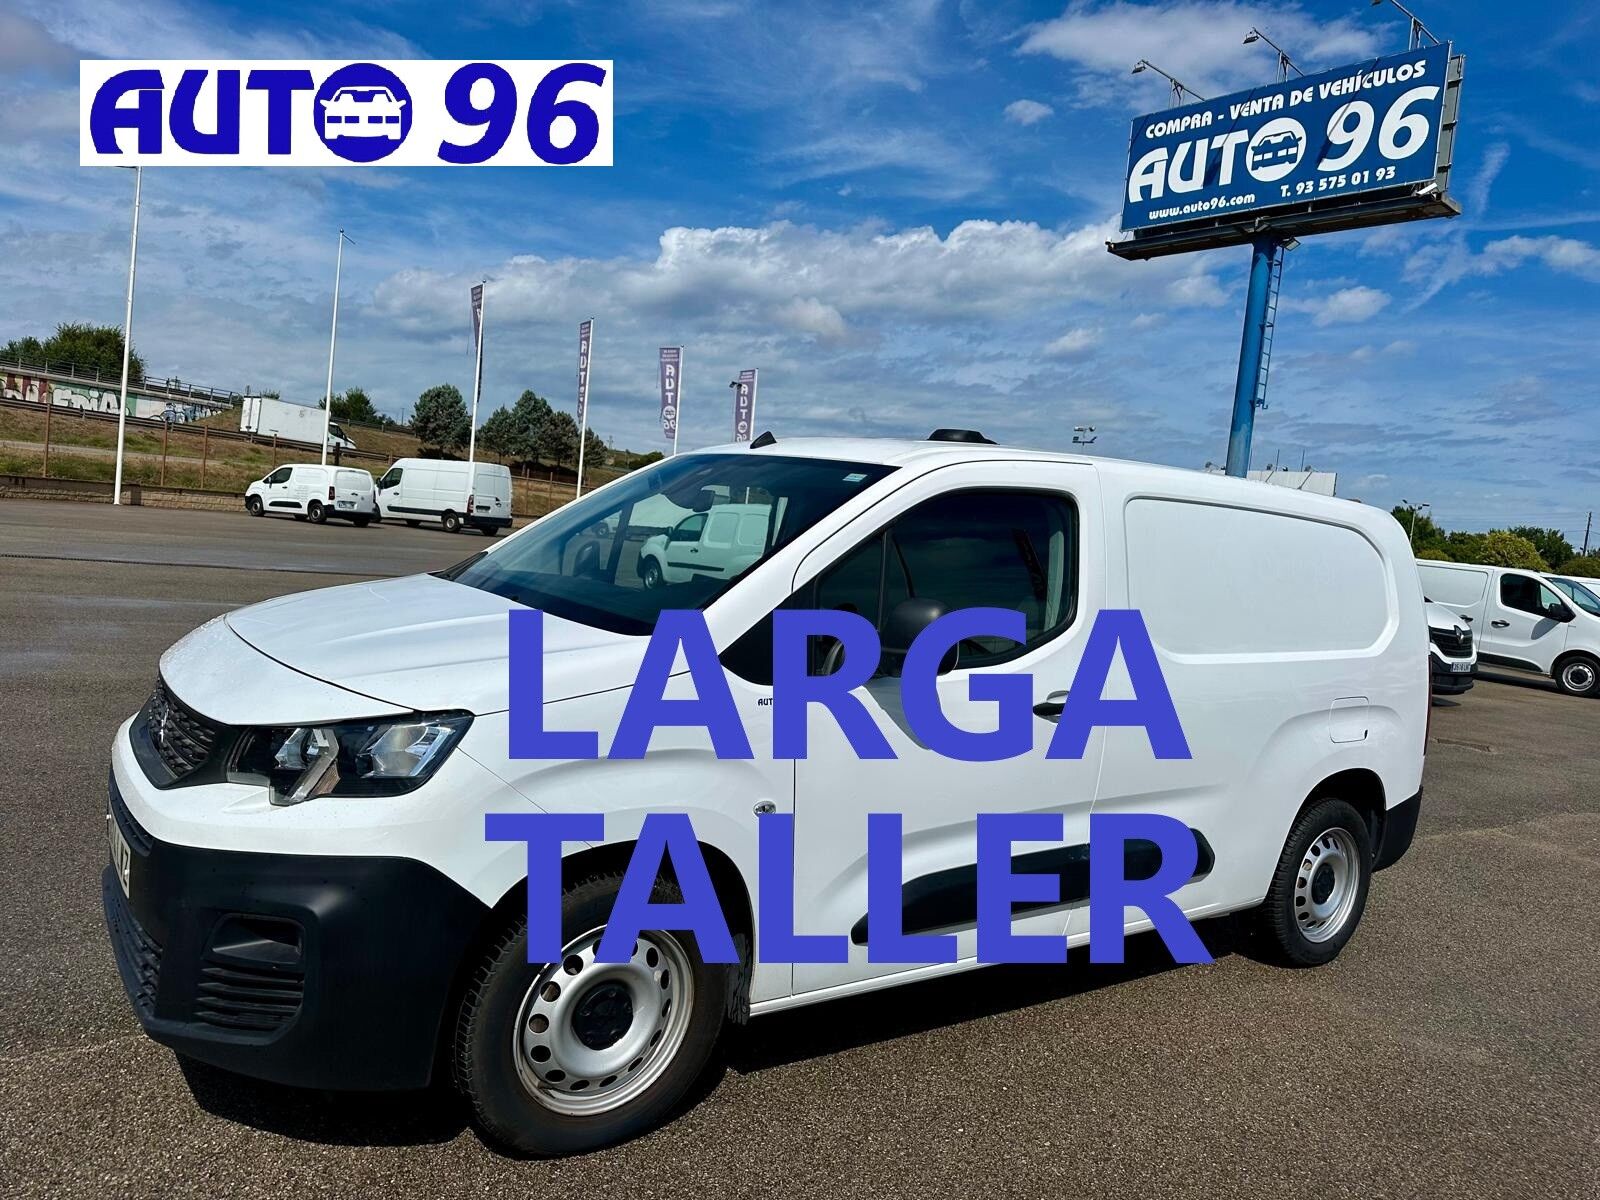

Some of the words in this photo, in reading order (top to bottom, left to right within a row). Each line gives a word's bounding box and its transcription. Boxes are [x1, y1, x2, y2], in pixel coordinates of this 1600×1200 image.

[1145, 110, 1213, 139] COMPRA
[1230, 94, 1284, 120] VENTA
[1290, 86, 1314, 107] DE
[1319, 59, 1427, 100] VEHÍCULOS
[1128, 117, 1307, 202] AUTO
[1316, 85, 1441, 172] 96
[1280, 184, 1292, 198] T.
[1296, 180, 1314, 196] 93
[1318, 174, 1347, 191] 575
[1351, 170, 1370, 186] 01
[1375, 166, 1396, 181] 93
[1148, 193, 1256, 220] www.auto96.com
[757, 698, 773, 706] AUT
